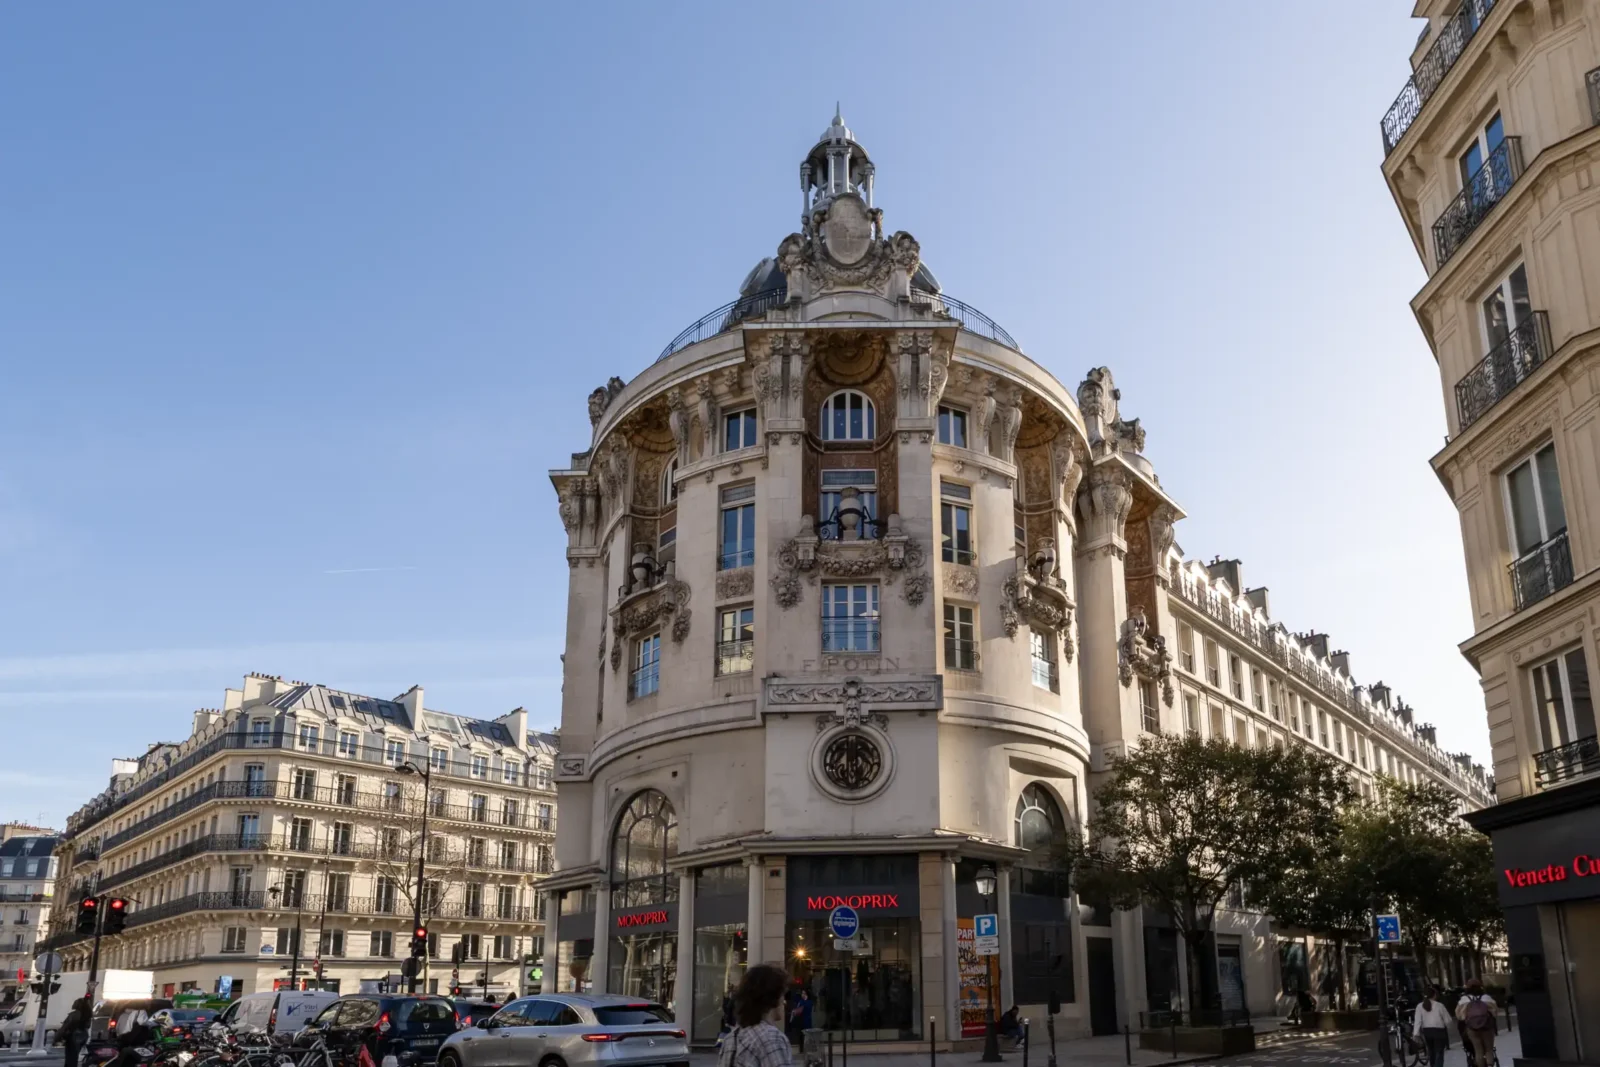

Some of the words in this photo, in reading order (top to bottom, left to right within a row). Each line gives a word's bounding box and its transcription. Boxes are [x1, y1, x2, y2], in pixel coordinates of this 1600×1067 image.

[827, 657, 900, 673] POTIN
[1504, 863, 1566, 887] Veneta
[807, 894, 899, 910] MONOPRIX
[617, 911, 668, 927] MONOPRIX
[980, 918, 992, 934] P
